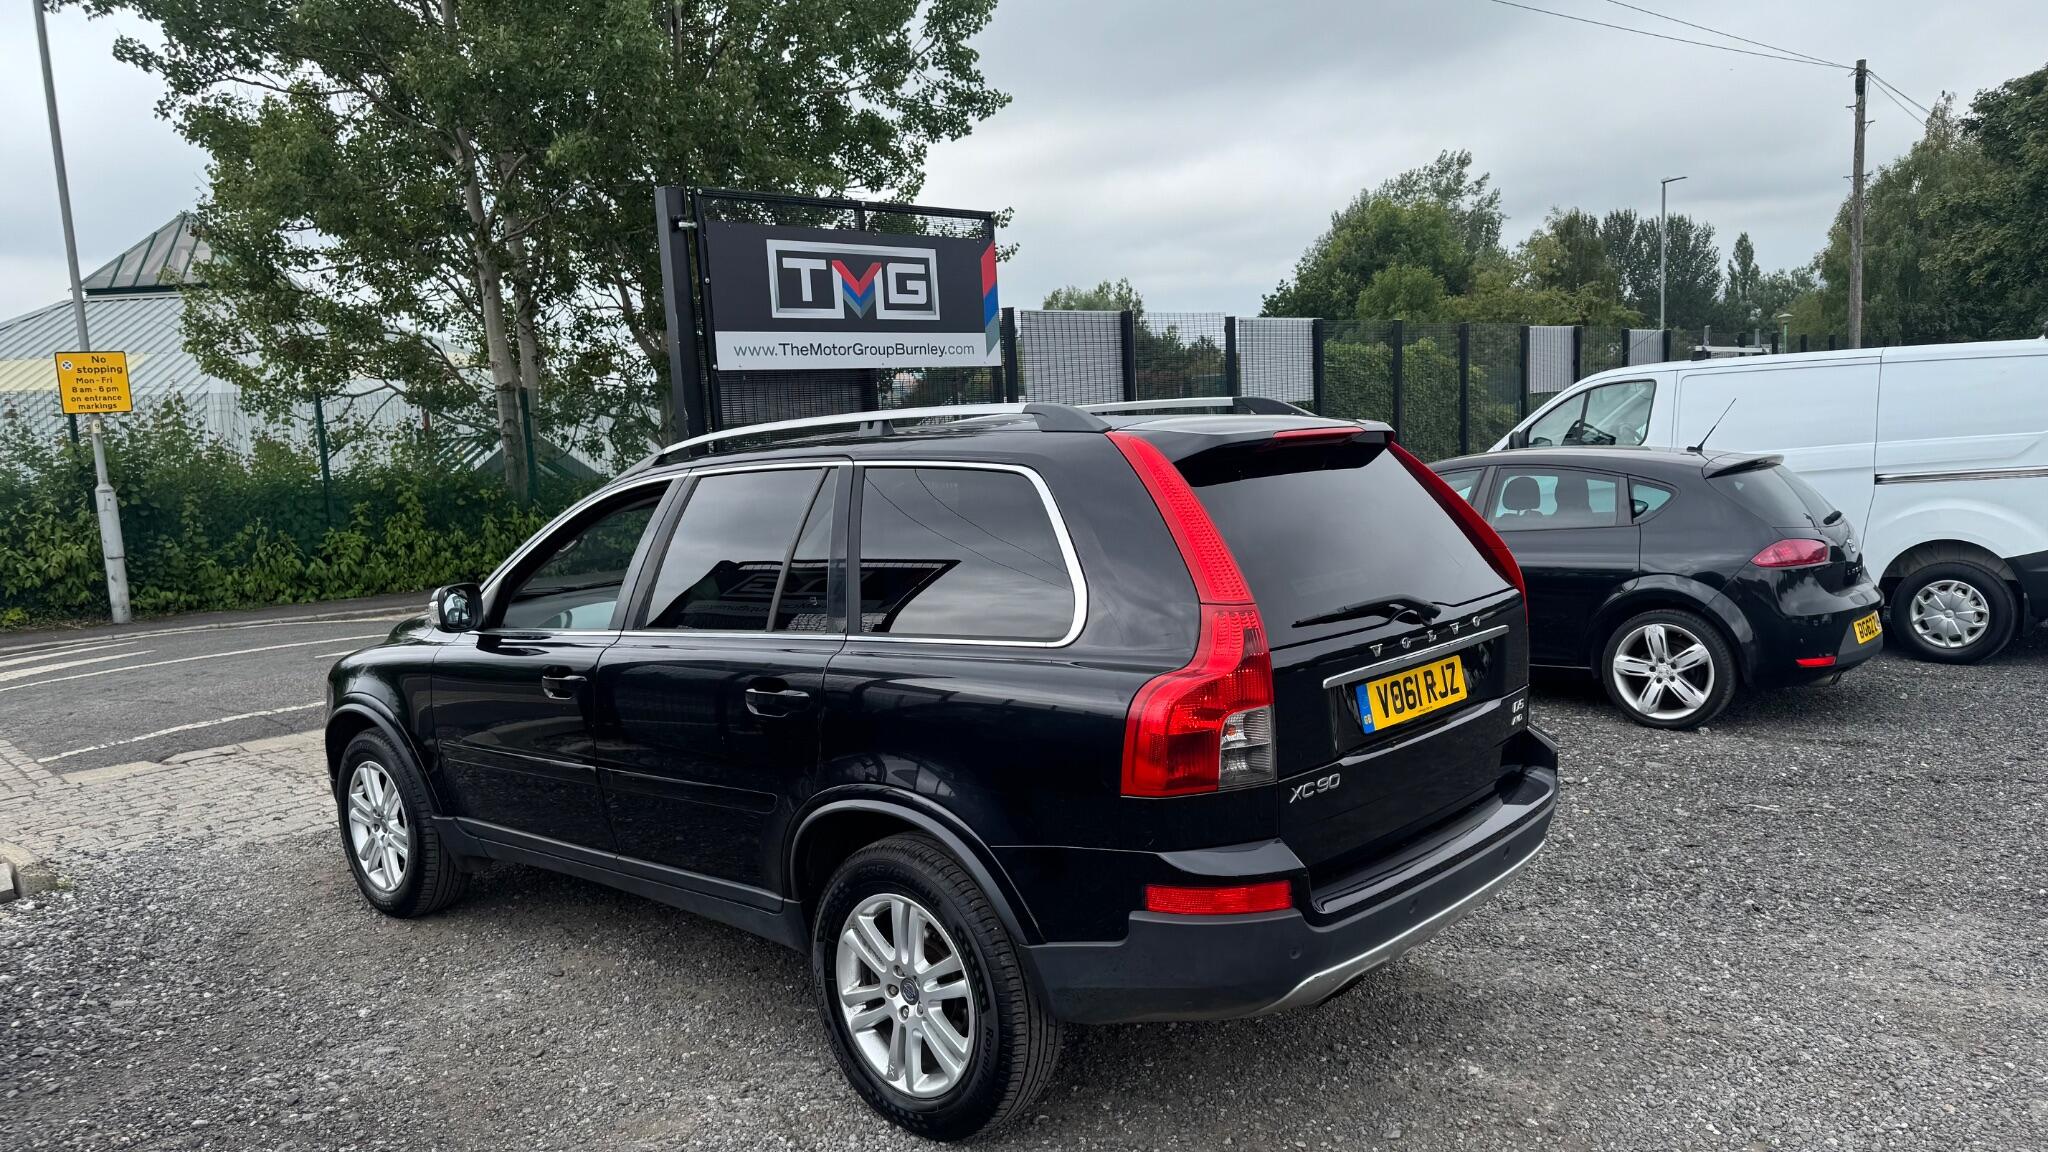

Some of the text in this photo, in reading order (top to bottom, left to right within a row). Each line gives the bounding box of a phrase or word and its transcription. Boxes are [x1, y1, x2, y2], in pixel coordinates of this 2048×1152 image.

[782, 256, 928, 320] TMG
[733, 342, 975, 358] www.TheMotorGroupBurnley.com
[77, 366, 123, 374] stopping
[1369, 615, 1481, 657] VOLVO
[1423, 661, 1460, 704] RJZ
[1289, 773, 1341, 804] XC90
